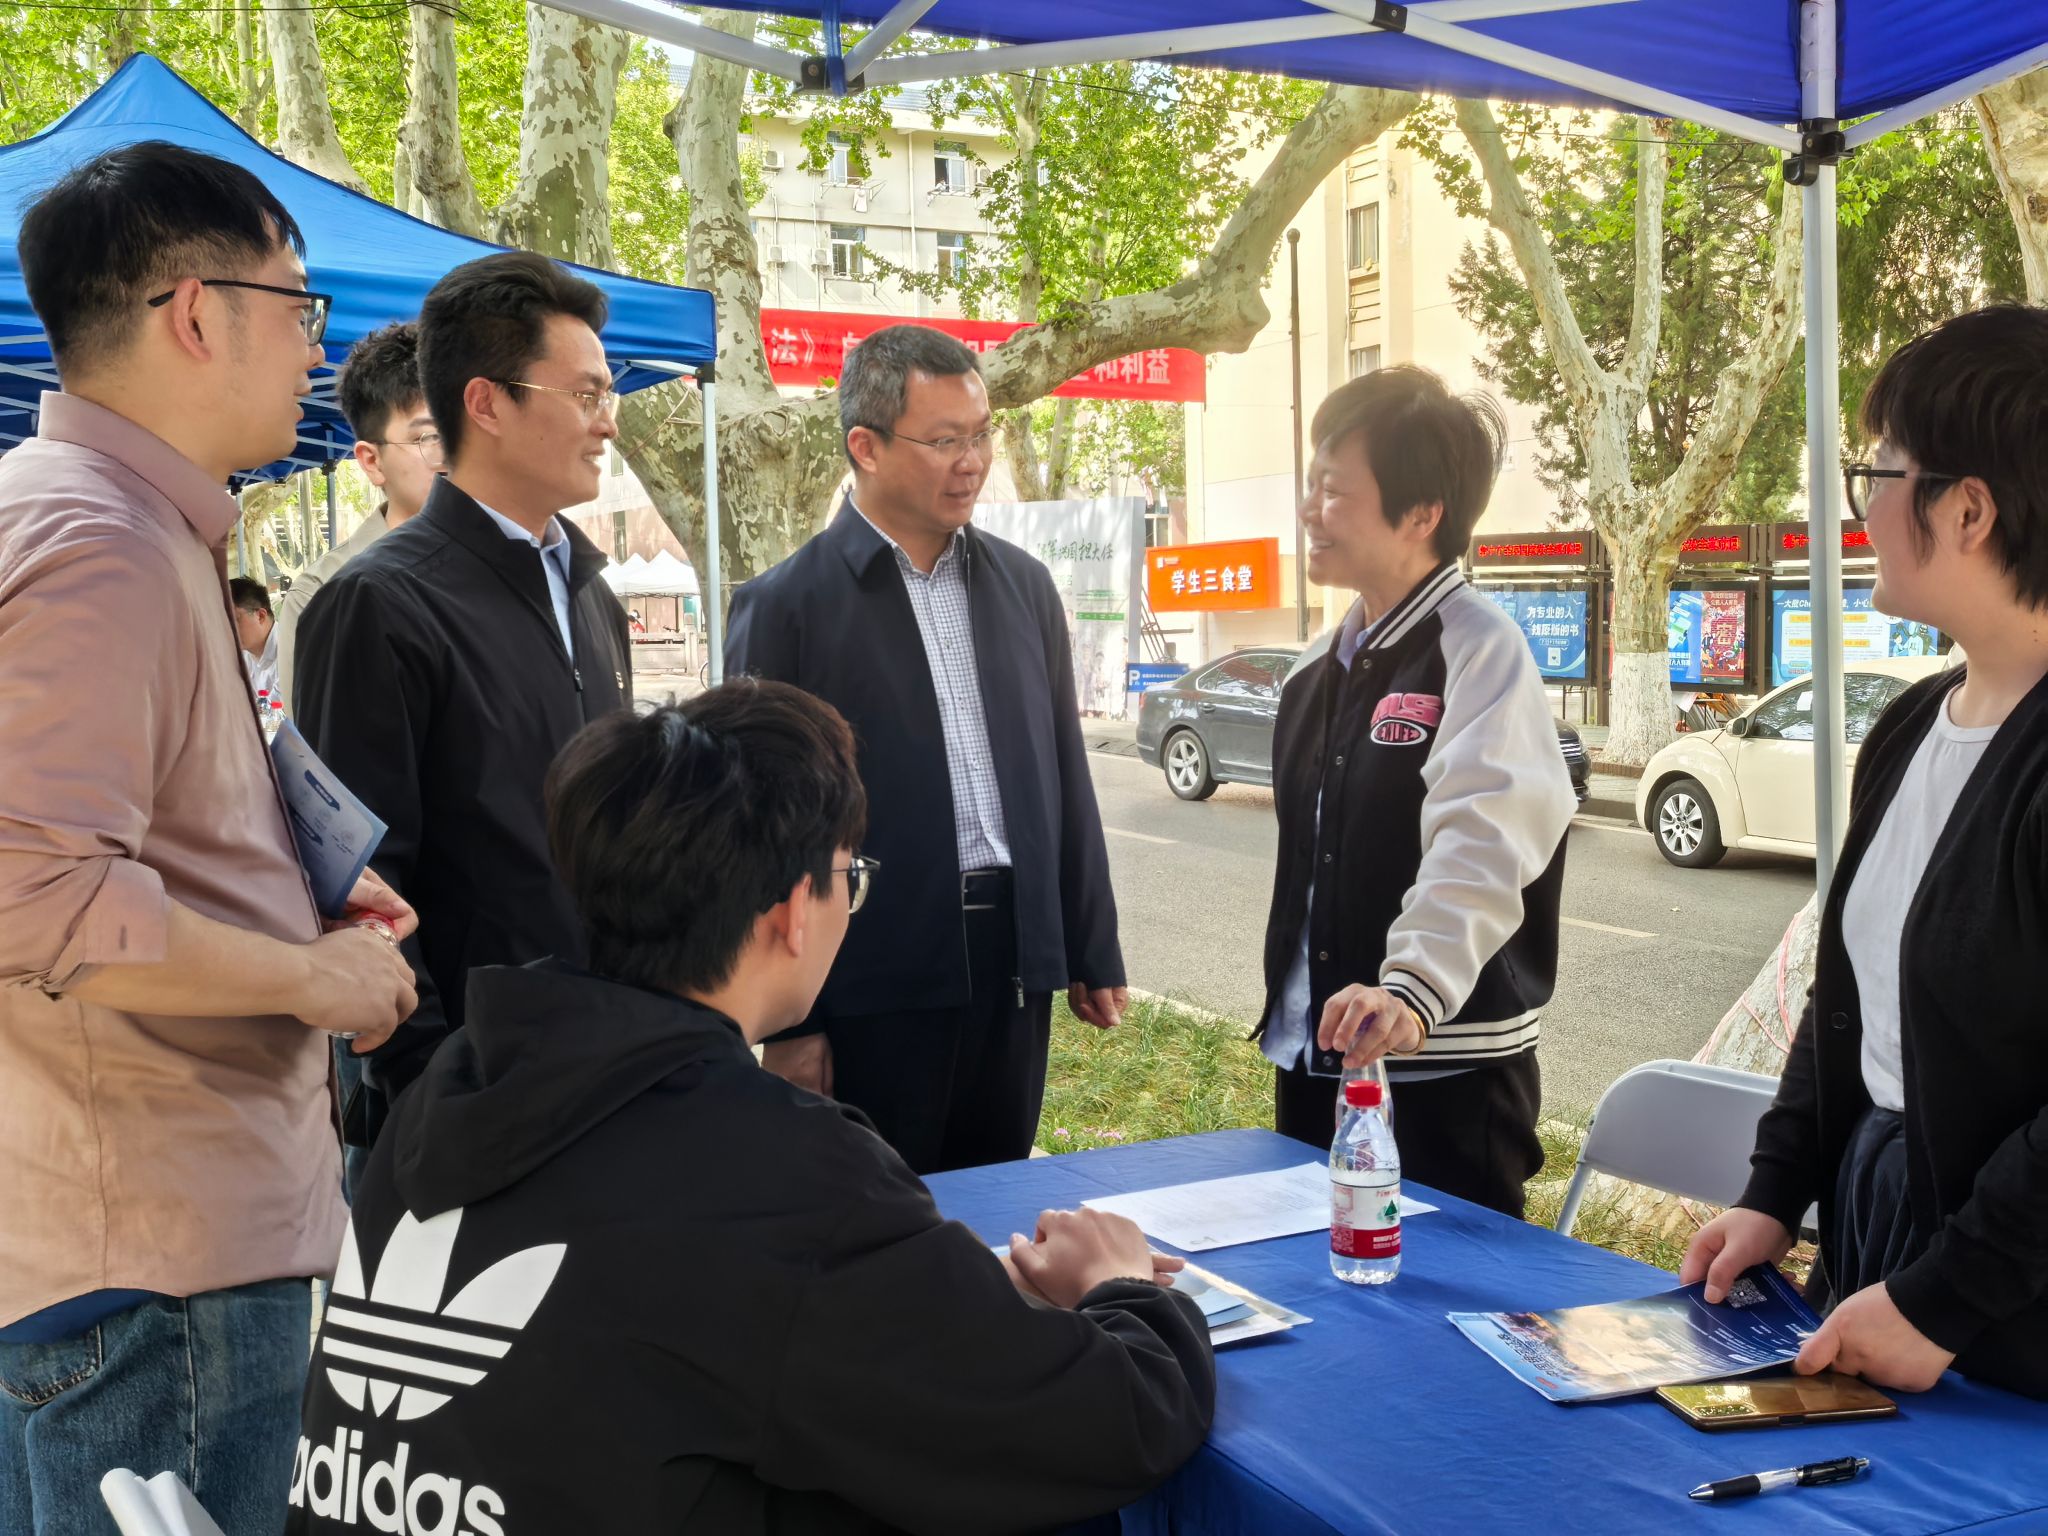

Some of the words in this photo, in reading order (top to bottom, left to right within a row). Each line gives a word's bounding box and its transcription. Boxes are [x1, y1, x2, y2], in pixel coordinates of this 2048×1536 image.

[1171, 565, 1253, 595] 学生三食堂
[1526, 606, 1574, 619] 为专业的人
[1129, 670, 1140, 686] P
[289, 1426, 506, 1536] adidas
